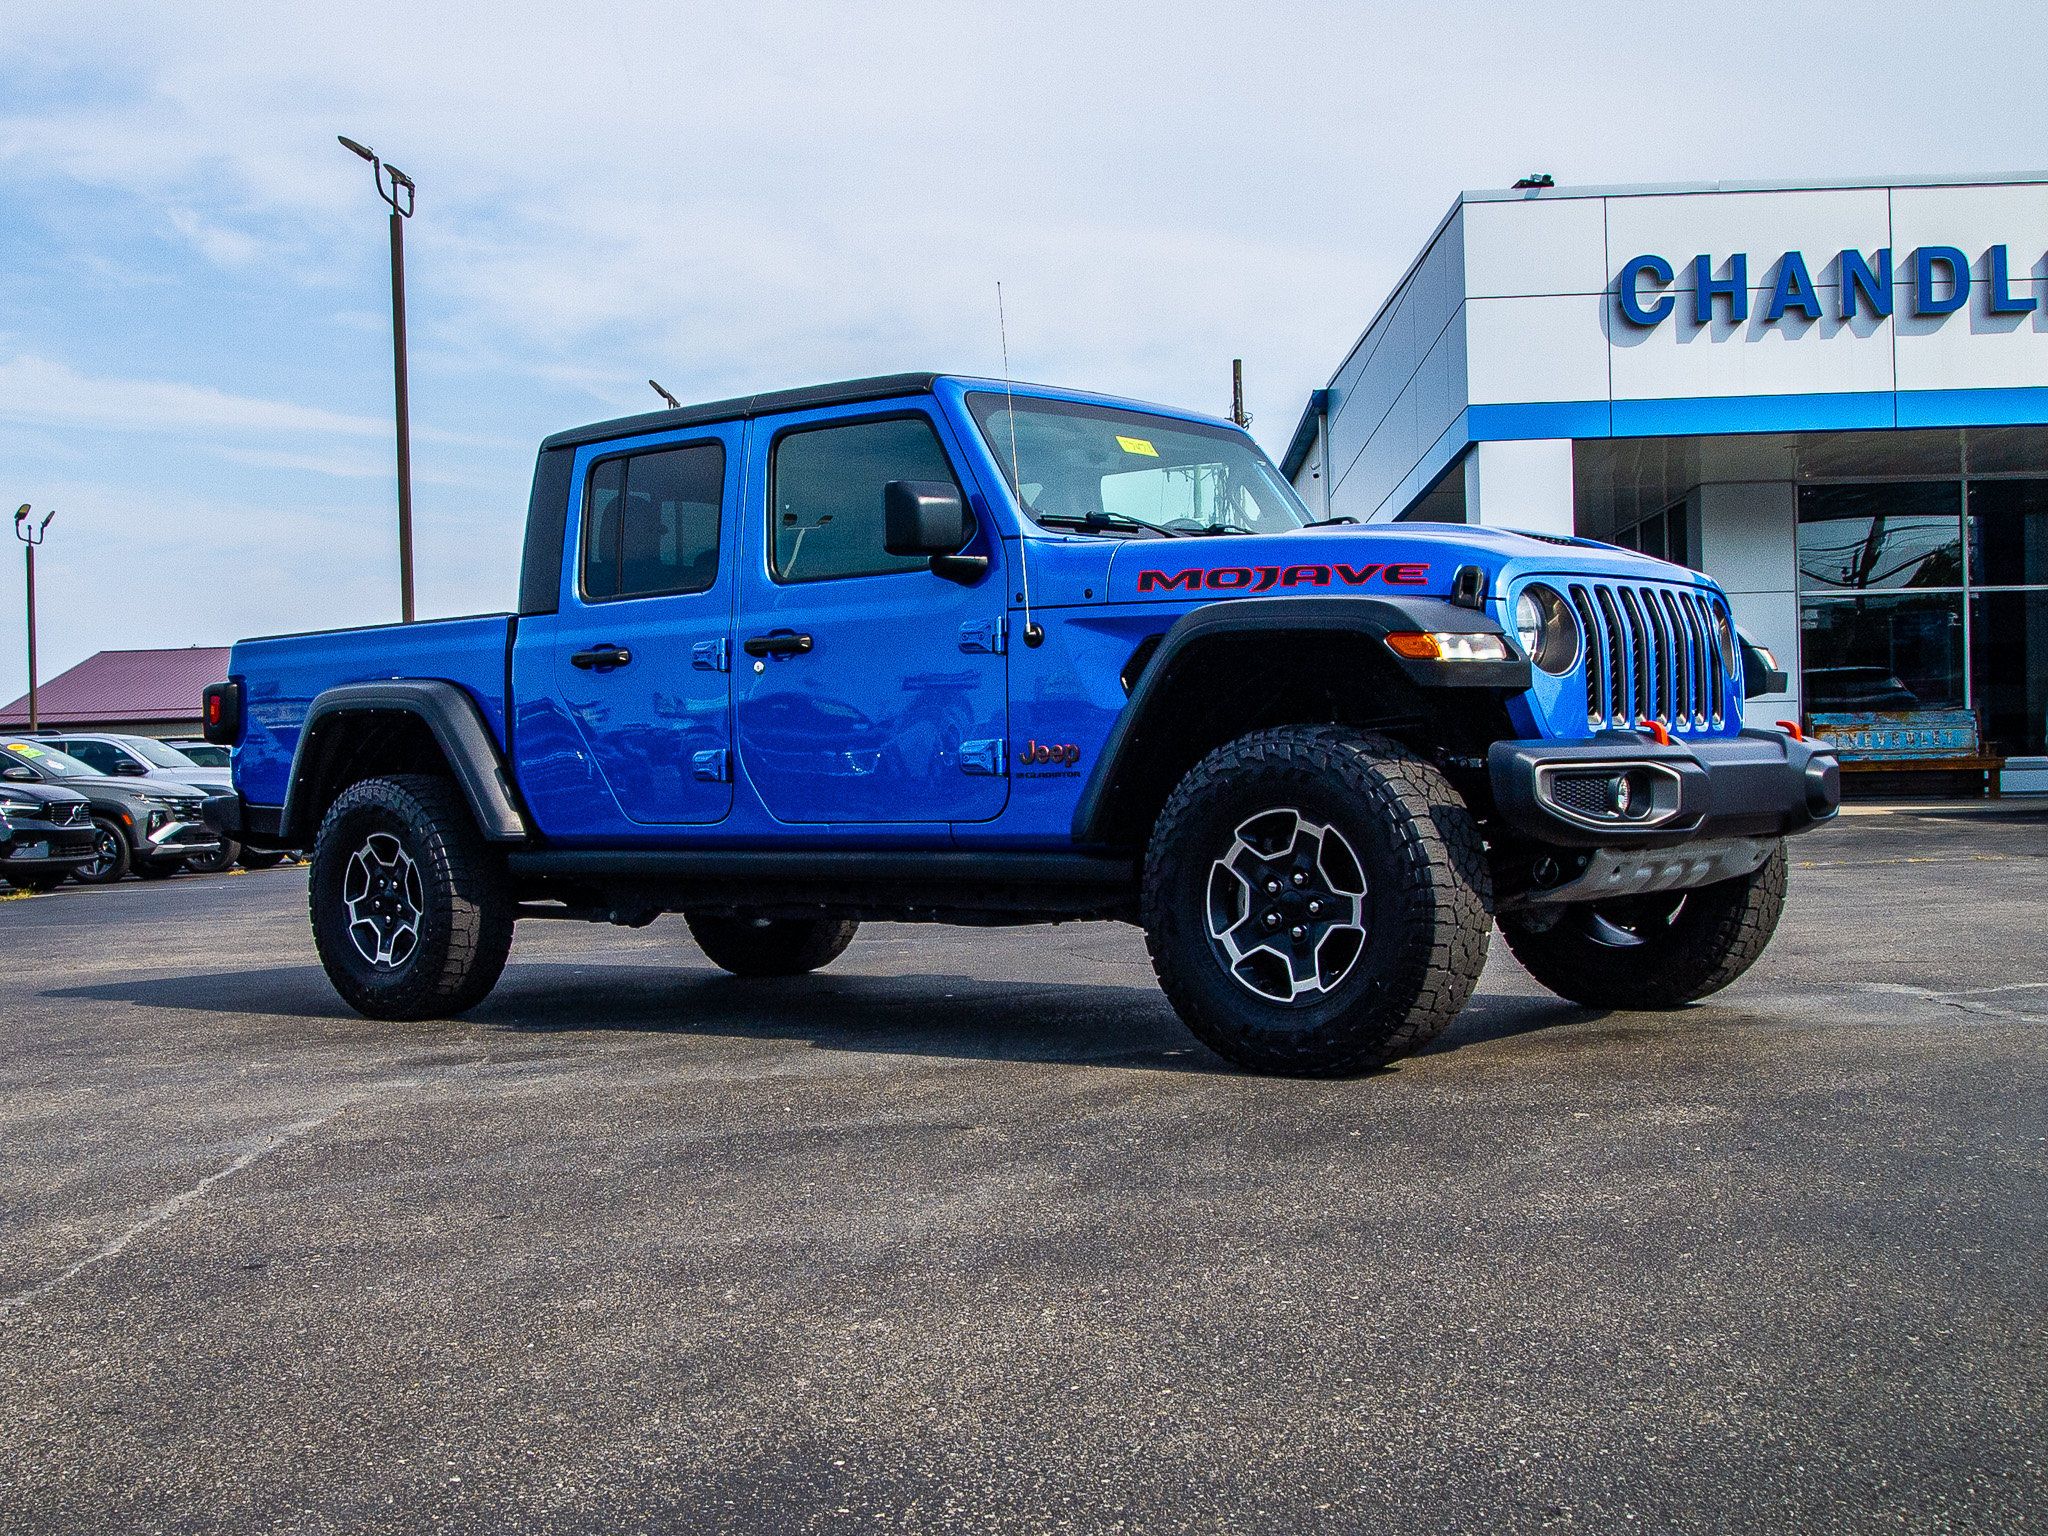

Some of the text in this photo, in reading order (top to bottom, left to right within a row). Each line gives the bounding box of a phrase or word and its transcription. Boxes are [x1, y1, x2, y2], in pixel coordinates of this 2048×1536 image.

[1620, 244, 2048, 326] CHANDL
[1137, 563, 1431, 592] MOJAVE
[1020, 740, 1080, 768] Jeep
